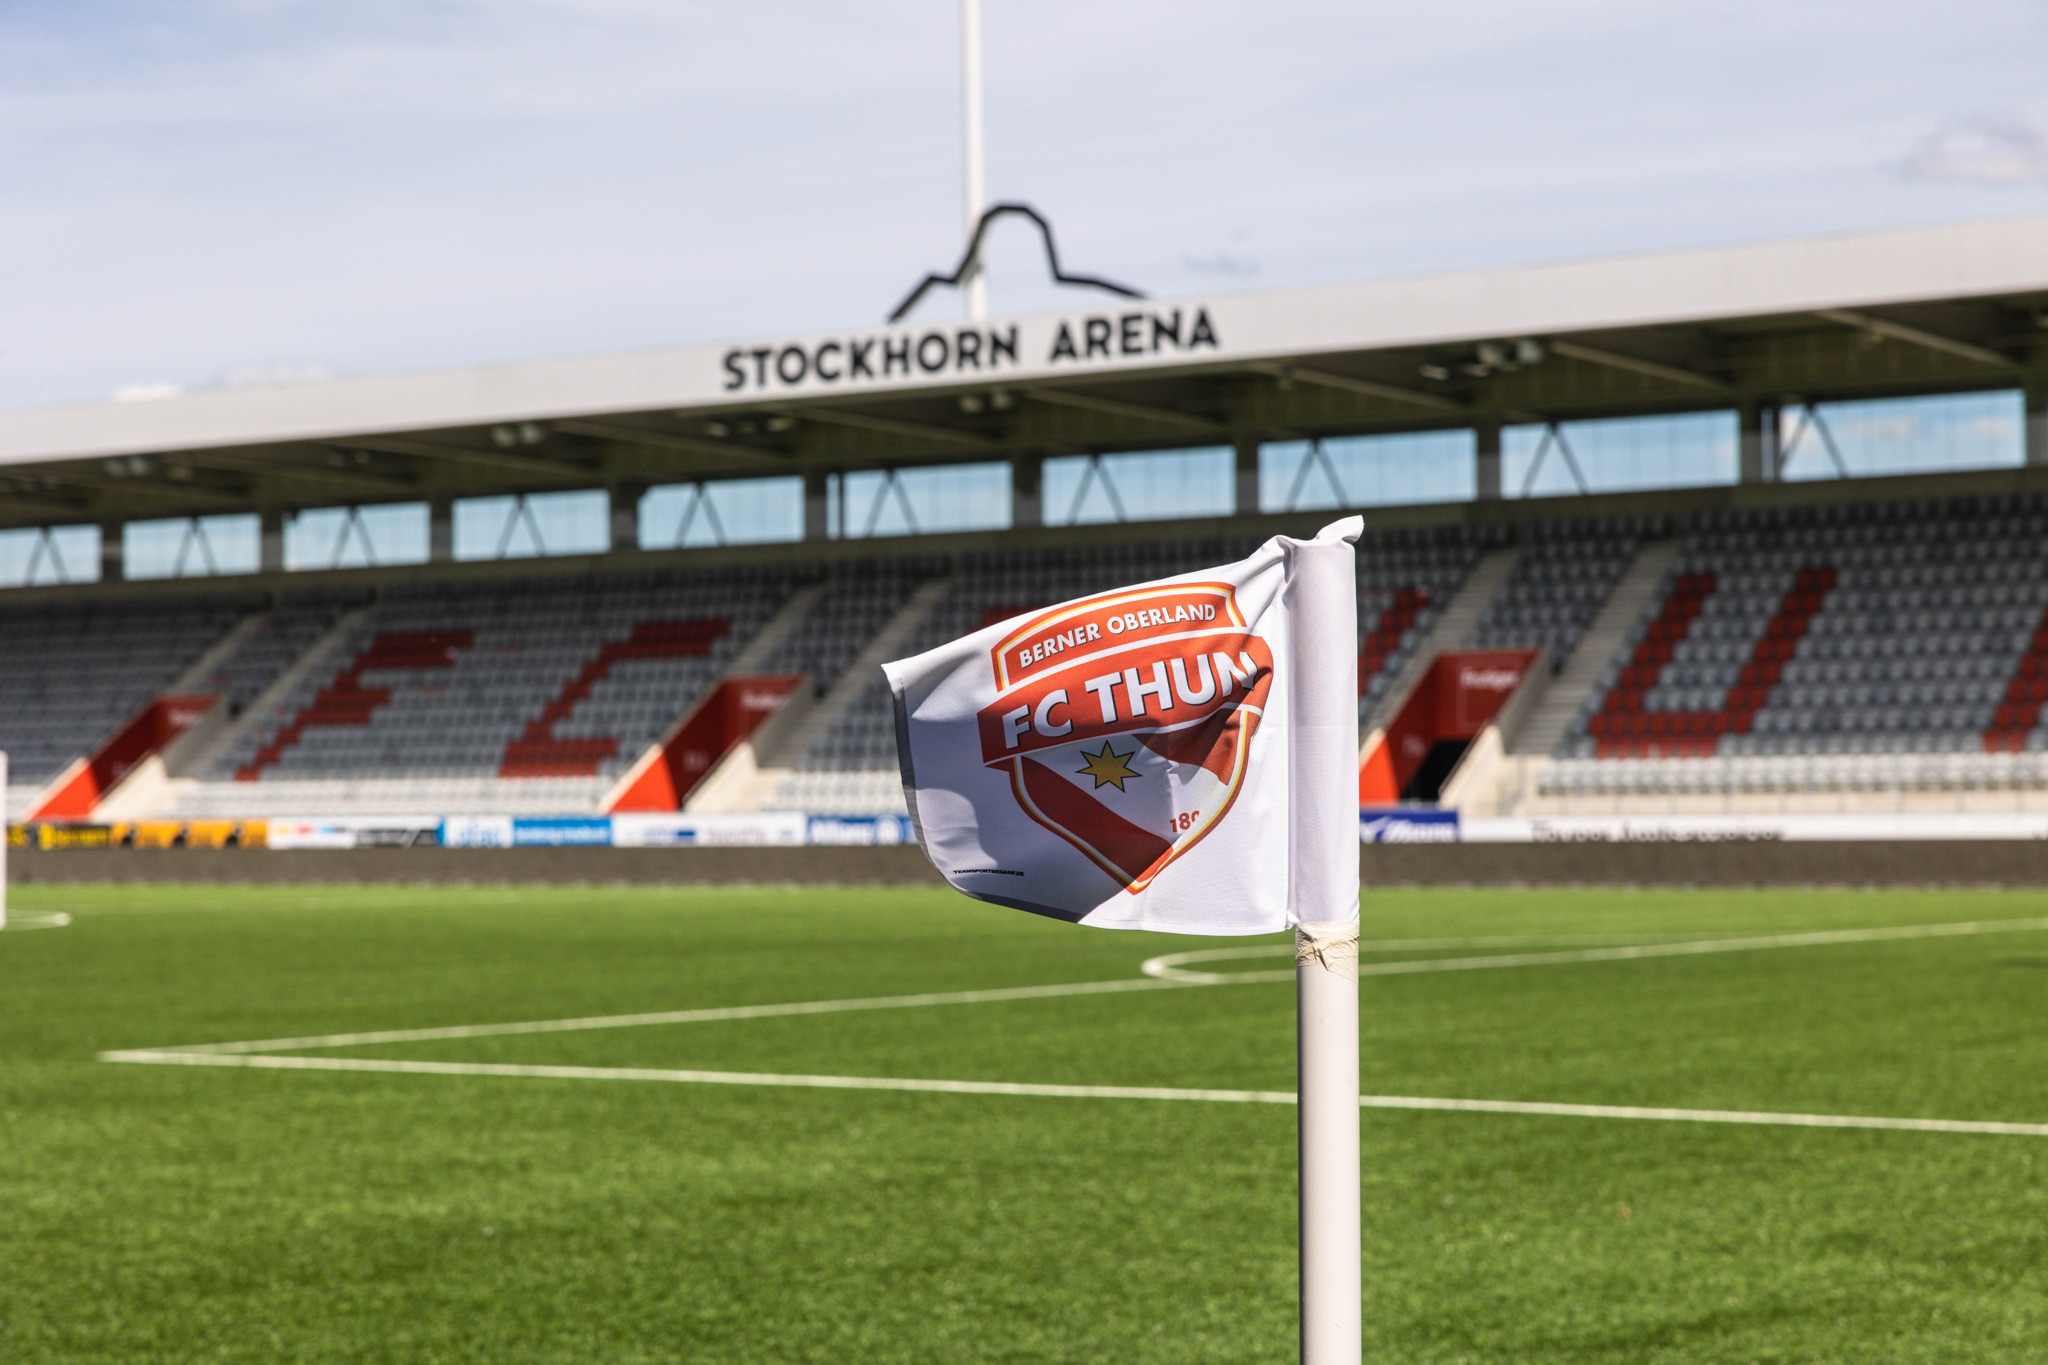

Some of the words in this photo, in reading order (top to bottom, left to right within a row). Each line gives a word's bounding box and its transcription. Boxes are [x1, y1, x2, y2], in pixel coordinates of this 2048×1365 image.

[723, 324, 1019, 391] STOCKHORN
[1049, 305, 1220, 363] ARENA
[1019, 622, 1102, 669] BERNER
[1107, 604, 1216, 635] OBERLAND
[1002, 689, 1073, 750] FC
[1084, 651, 1258, 725] THUN
[953, 868, 1025, 877] TEAMSPORTBEDARF.DE
